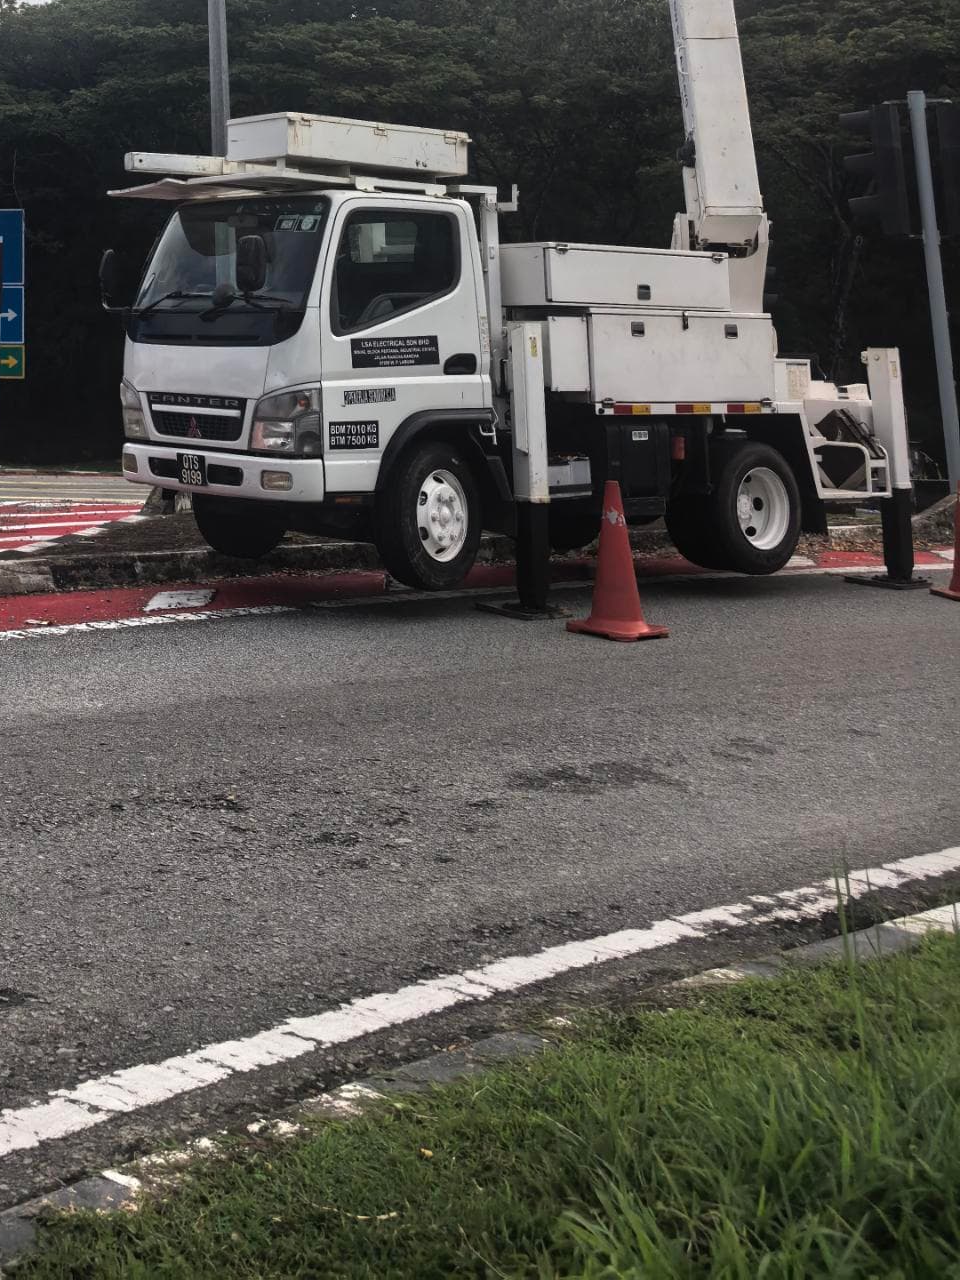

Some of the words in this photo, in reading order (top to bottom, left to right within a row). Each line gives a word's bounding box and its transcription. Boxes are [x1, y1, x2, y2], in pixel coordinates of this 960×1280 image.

[150, 394, 240, 407] CANTER
[330, 424, 346, 435] BDM
[346, 423, 366, 434] 7010
[366, 423, 377, 433] KG
[330, 435, 346, 446] BTM
[346, 434, 366, 445] 7500
[367, 434, 377, 444] KG
[182, 454, 199, 470] QTS
[181, 469, 202, 485] 9199
